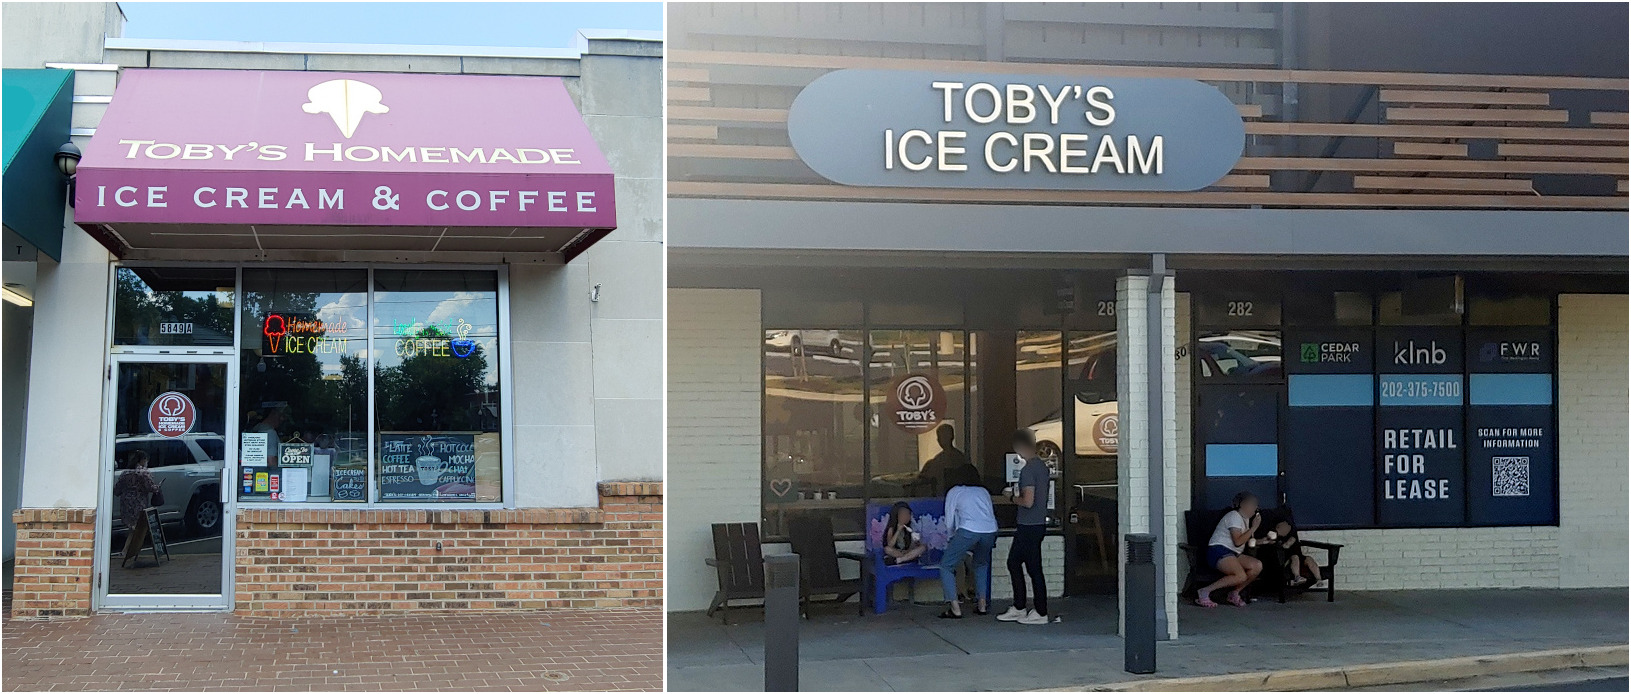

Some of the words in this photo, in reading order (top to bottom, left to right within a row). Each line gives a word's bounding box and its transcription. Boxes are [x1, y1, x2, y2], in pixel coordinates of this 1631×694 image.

[931, 81, 1116, 127] TOBY'S
[118, 139, 287, 161] TOBY'S
[304, 141, 582, 165] HOMEMADE
[884, 129, 968, 171] ICE
[984, 131, 1163, 174] CREAM
[97, 185, 168, 208] ICE
[193, 186, 344, 210] CREAM
[371, 186, 400, 211] &
[426, 188, 597, 213] COFFEE
[1228, 301, 1253, 316] 282
[287, 316, 348, 334] Homemade
[286, 337, 304, 353] ICE
[308, 337, 348, 354] CREAM
[395, 340, 450, 357] COFFEE
[1321, 343, 1359, 353] CEDAR
[1394, 341, 1446, 364] klnb
[1321, 353, 1351, 362] PARK
[1382, 381, 1460, 398] 202-375-7500
[896, 409, 936, 421] TOBY'S
[1384, 429, 1457, 449] RETAIL
[1478, 428, 1499, 437] SCAN
[1502, 428, 1518, 437] FOR
[1520, 428, 1544, 437] MORE
[1483, 440, 1540, 448] INFORMATION
[281, 455, 311, 464] OPEN
[382, 454, 411, 464] COFFEE
[448, 454, 475, 464] MOCHA
[1384, 454, 1425, 474] FOR
[382, 465, 398, 473] HOT
[398, 464, 415, 473] TEA
[381, 475, 414, 485] ESPRESSO
[1384, 479, 1449, 499] LEASE
